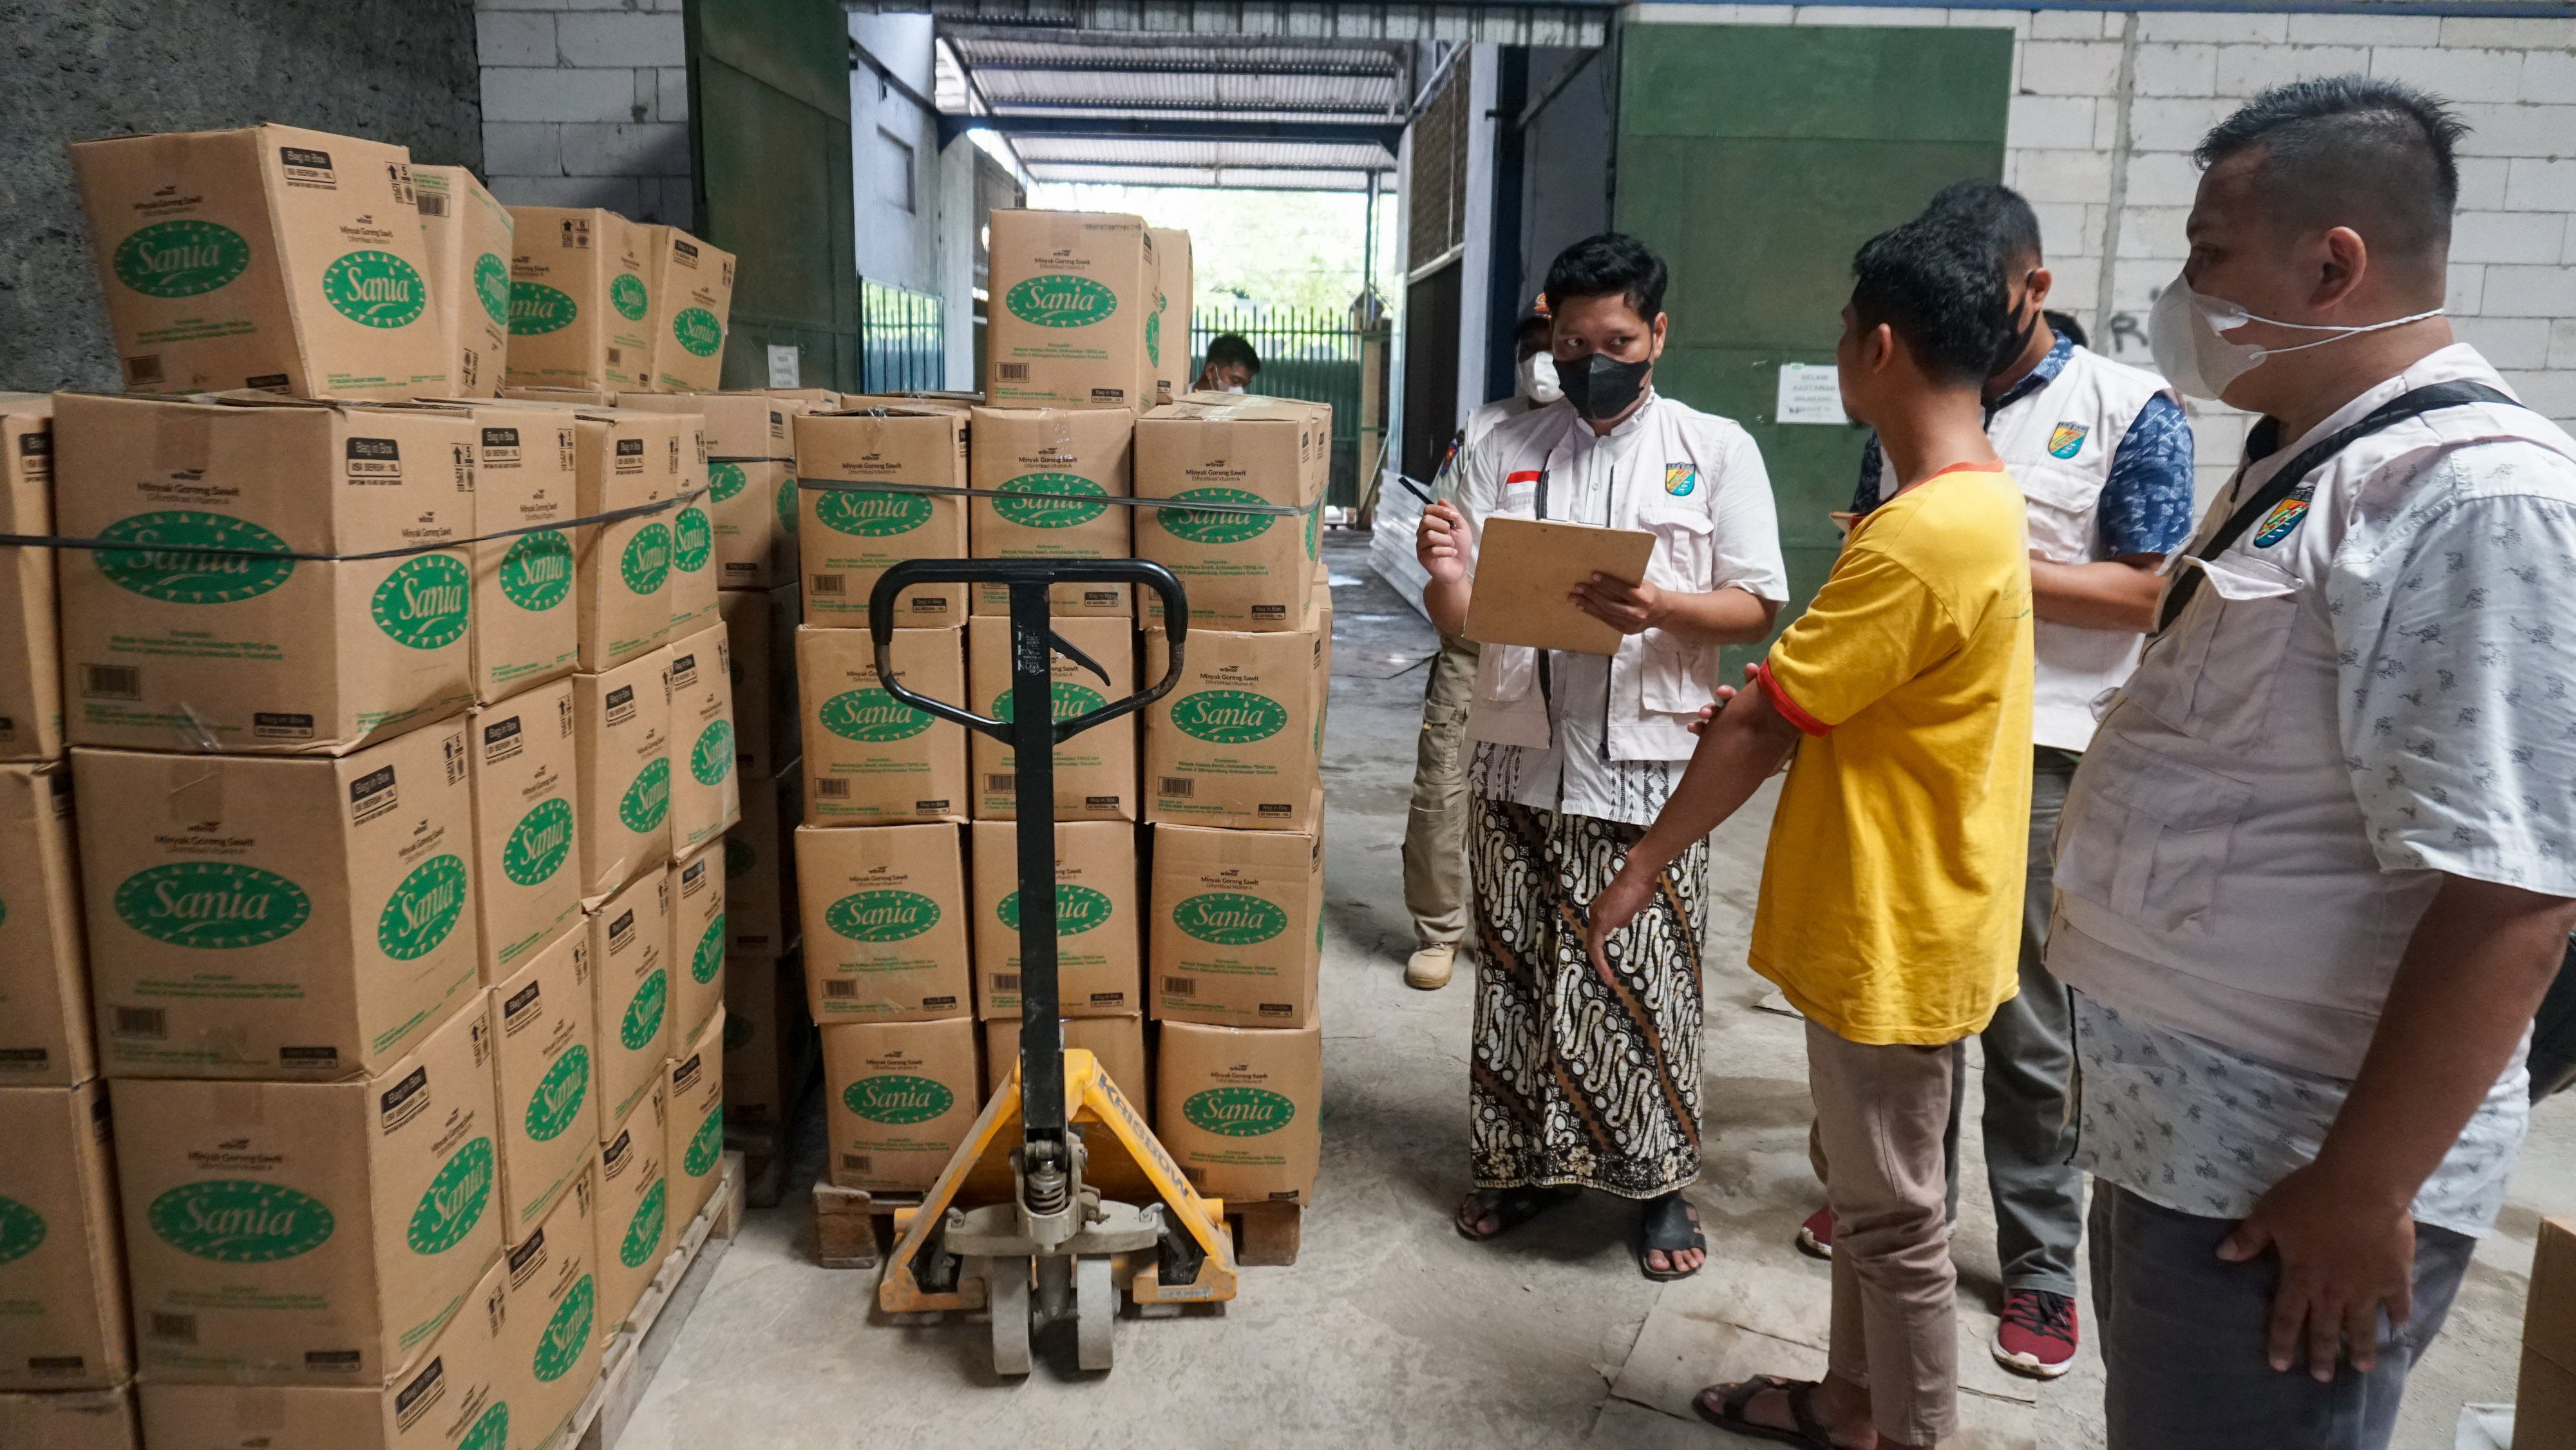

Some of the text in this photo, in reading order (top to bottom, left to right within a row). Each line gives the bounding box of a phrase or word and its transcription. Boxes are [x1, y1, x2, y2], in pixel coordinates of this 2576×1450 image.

[136, 234, 220, 275] Sania
[346, 266, 409, 303] Sania
[620, 283, 643, 308] Sania
[1026, 285, 1095, 310] Sania
[510, 292, 554, 318] nia
[684, 316, 715, 343] Sania
[355, 443, 371, 456] Bag
[379, 444, 393, 453] Box
[487, 431, 499, 443] Bag
[505, 432, 515, 441] Box
[837, 493, 909, 519] Sania
[1012, 482, 1085, 510] Sania
[1178, 500, 1251, 525] Sania
[677, 519, 706, 553] Sania
[127, 529, 253, 574] Sania
[634, 535, 667, 573] Sania
[519, 545, 564, 587] Sania
[400, 573, 462, 620] Sania
[840, 699, 912, 724] Sania
[1052, 691, 1084, 718] nia
[1192, 701, 1265, 727] Sania
[355, 780, 370, 795] Bag
[377, 772, 389, 785] Box
[636, 772, 668, 815] Sania
[520, 812, 564, 865] Sania
[149, 879, 269, 920] Sania
[399, 871, 455, 937] Sania
[846, 899, 917, 926] Sania
[1056, 893, 1090, 919] nia
[1193, 903, 1265, 929] Sania
[388, 1089, 401, 1104] Bag
[409, 1074, 421, 1090] Box
[542, 1061, 581, 1123] Sania
[862, 1085, 931, 1109] Sania
[1203, 1097, 1274, 1121] Sania
[1098, 1073, 1189, 1199] KRISBOW
[431, 1158, 486, 1233] Sania
[180, 1197, 296, 1237] Sania
[551, 1297, 589, 1362] Sania
